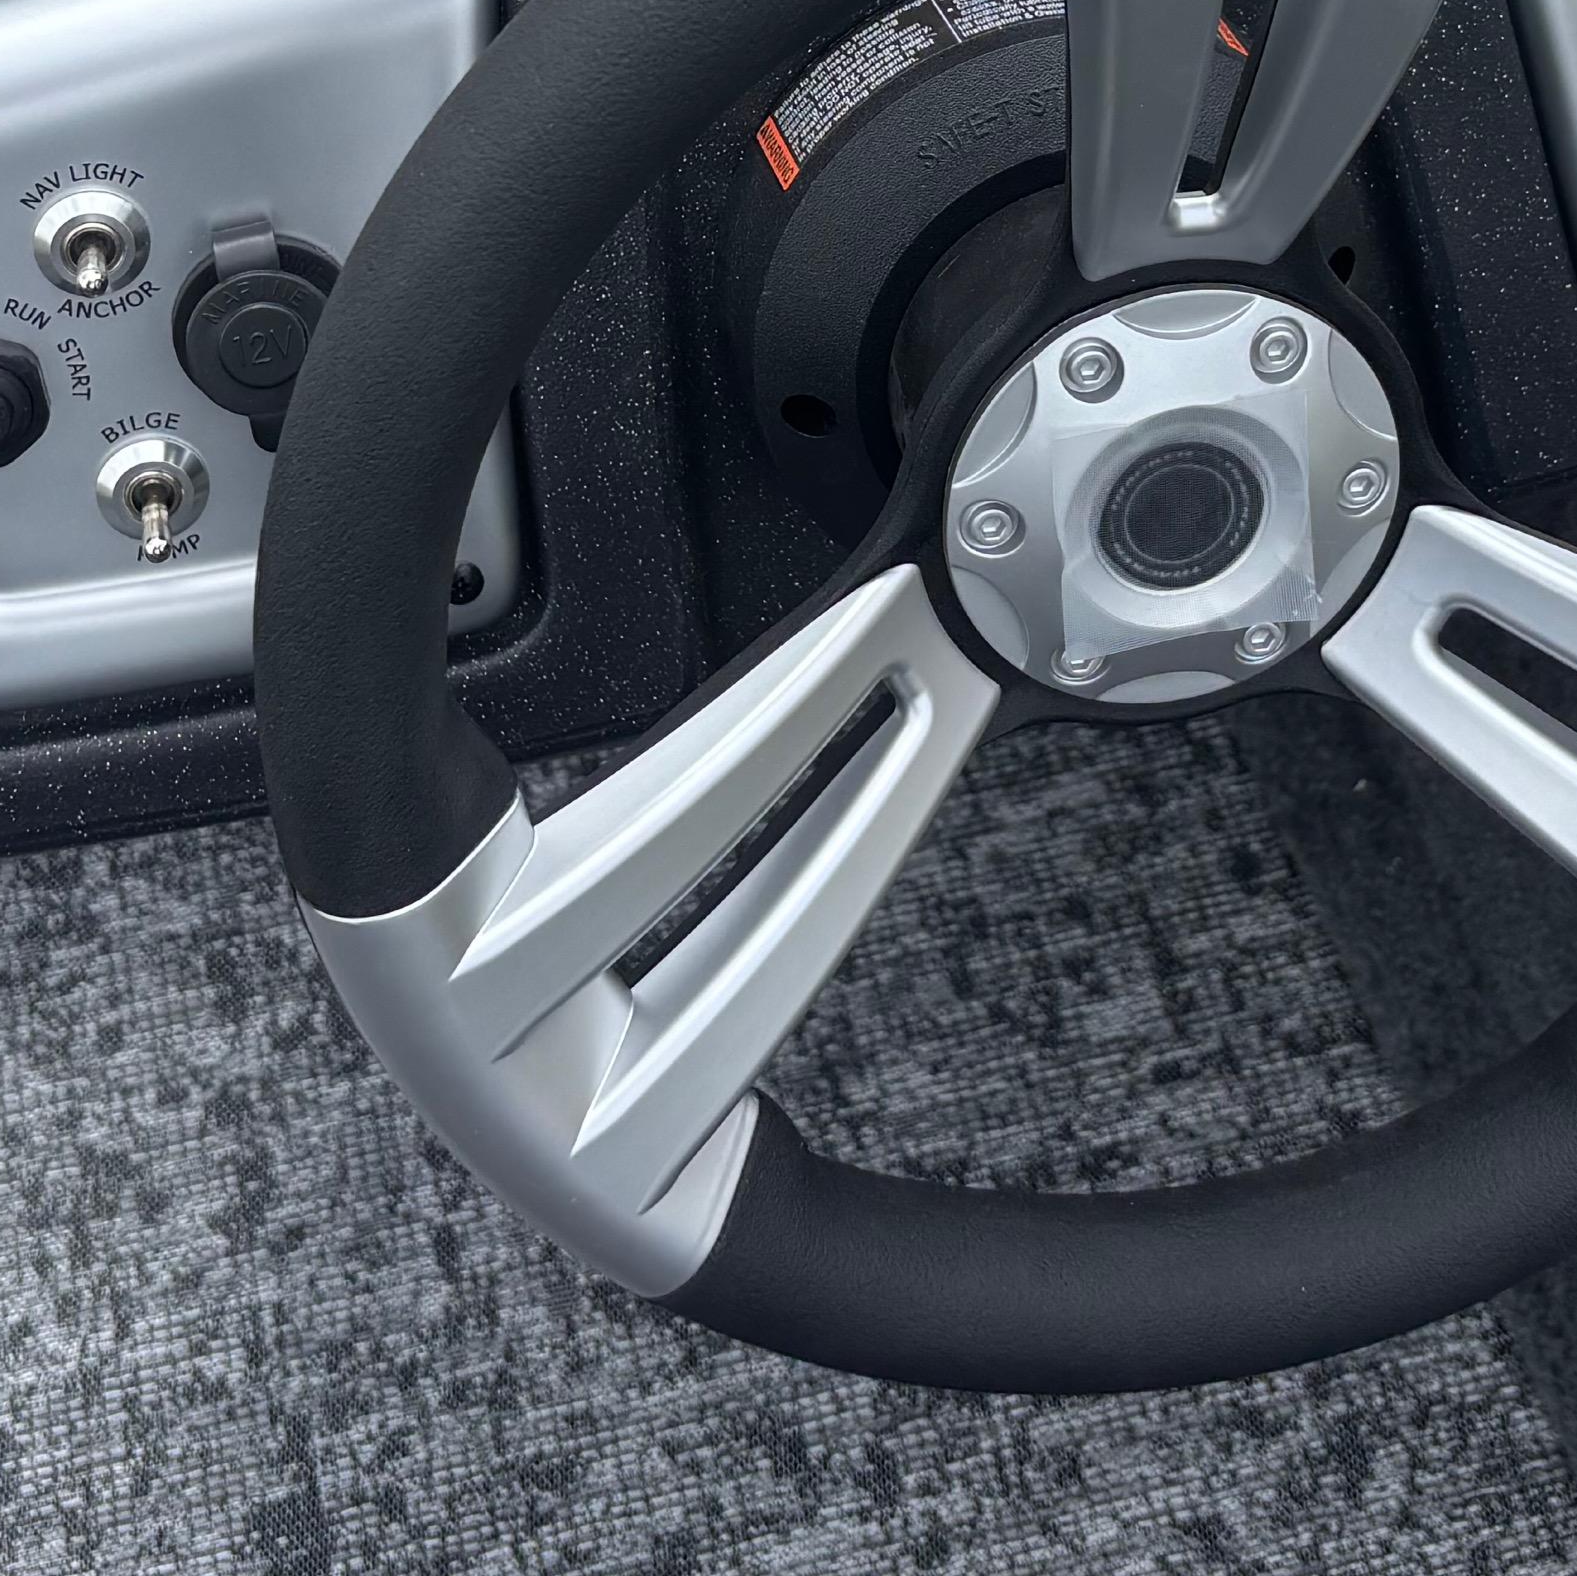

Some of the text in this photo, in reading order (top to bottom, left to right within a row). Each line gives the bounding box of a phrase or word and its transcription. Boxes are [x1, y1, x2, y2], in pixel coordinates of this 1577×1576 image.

[826, 94, 840, 110] DO
[841, 75, 860, 96] NOT
[764, 127, 794, 184] WARNING
[19, 162, 145, 210] NAV LIGHT
[3, 298, 52, 330] RUN
[57, 280, 161, 319] ANCHOR
[233, 324, 292, 367] 12V
[57, 338, 91, 401] START
[101, 411, 181, 445] BILGE
[137, 534, 200, 562] MP
